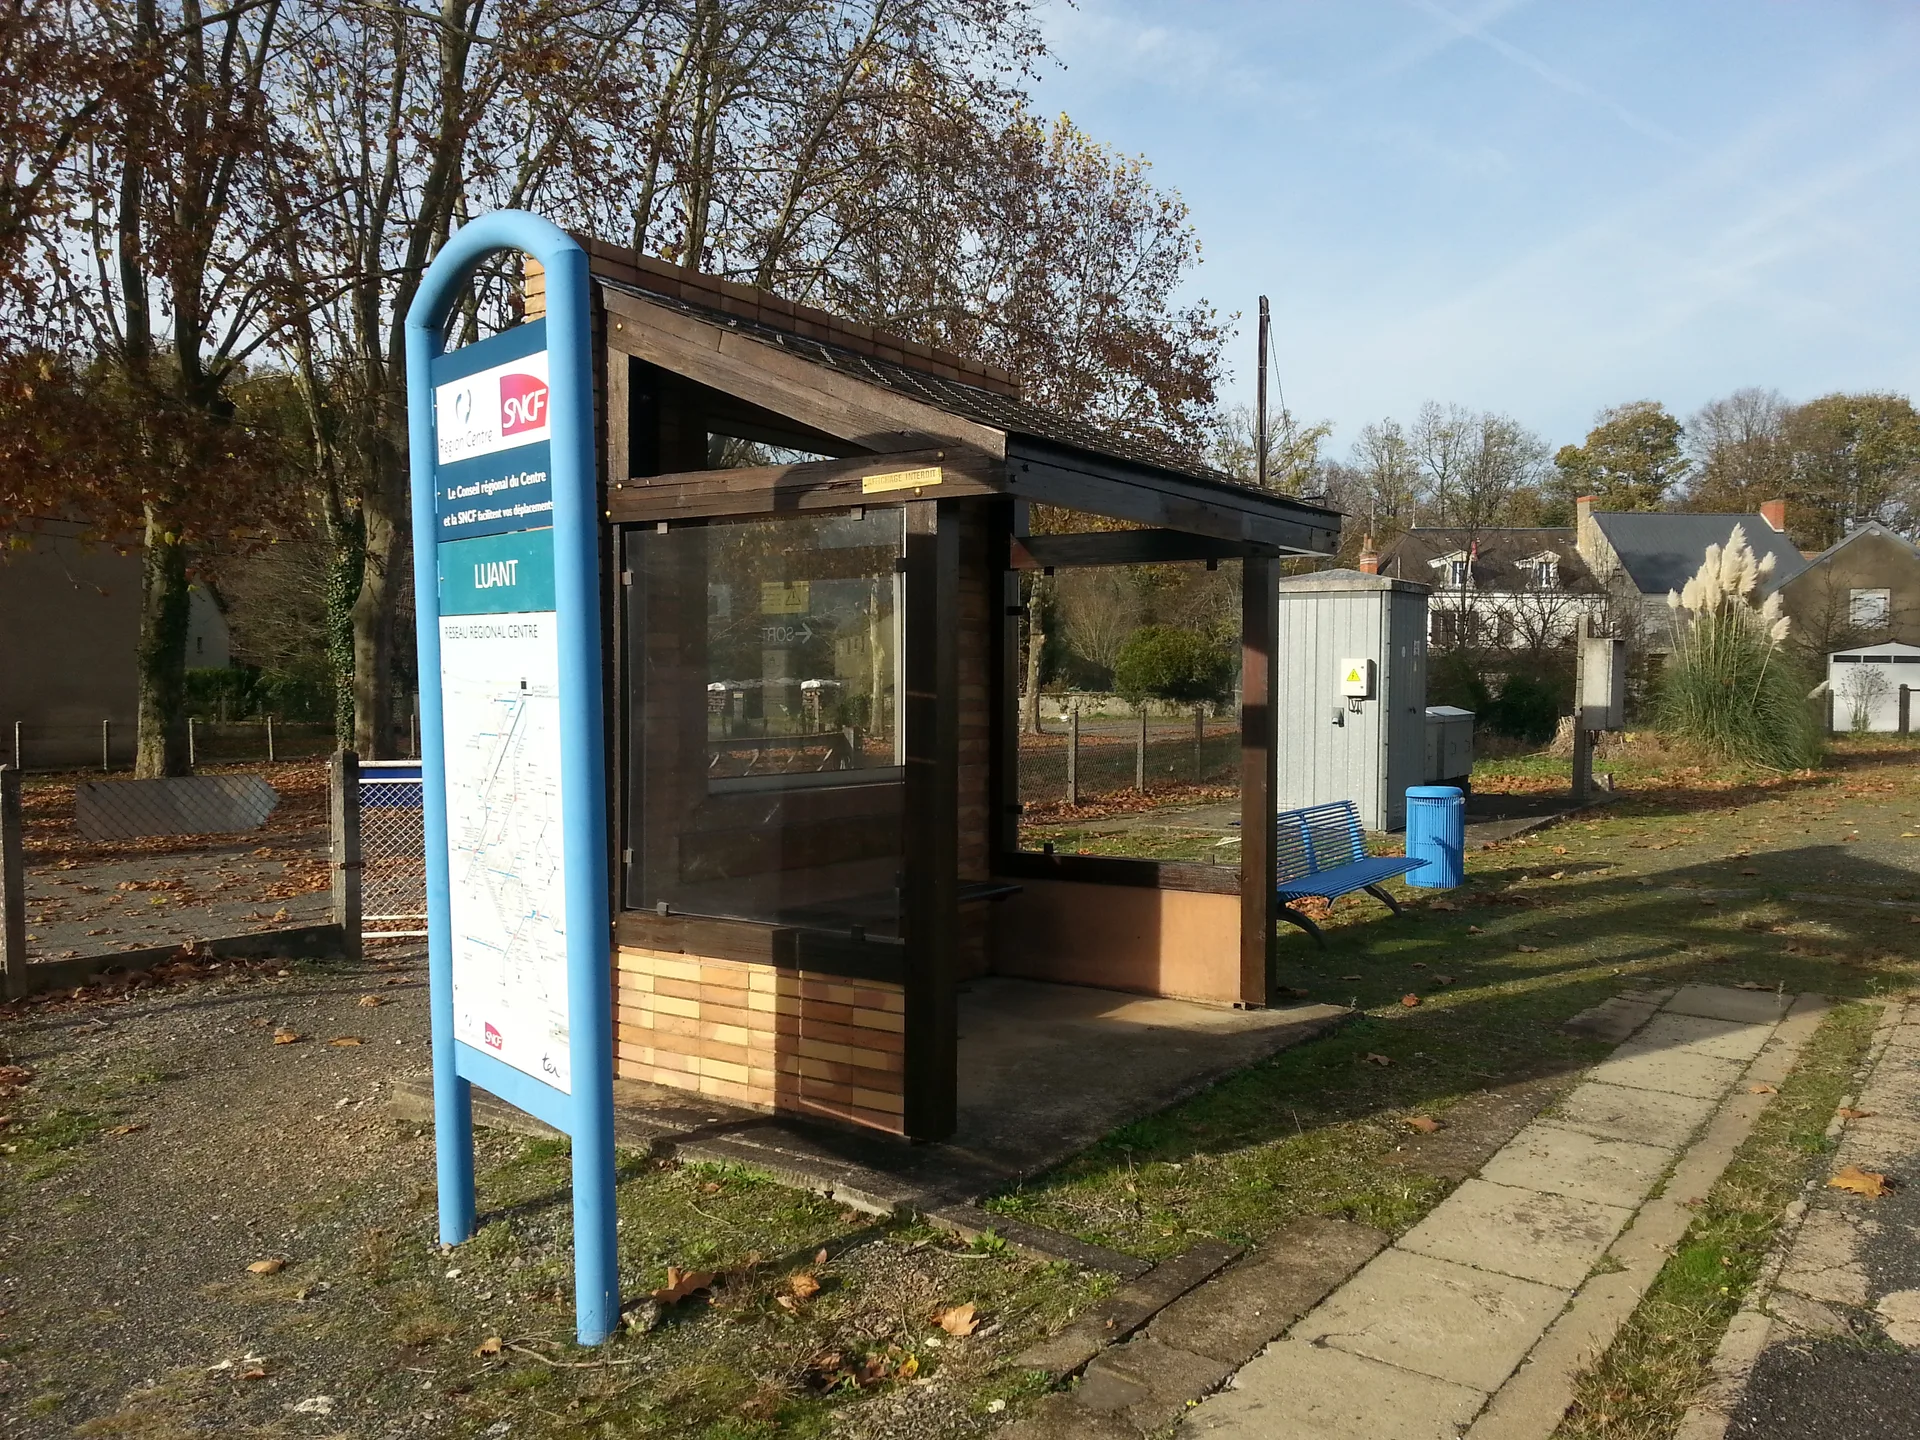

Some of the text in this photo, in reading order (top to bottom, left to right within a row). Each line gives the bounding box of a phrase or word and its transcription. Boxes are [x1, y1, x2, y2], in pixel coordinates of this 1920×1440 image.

[503, 388, 547, 429] SNCF
[466, 430, 492, 447] Centre
[448, 471, 546, 500] Le Conseil régional du Centre
[867, 469, 937, 486] AFFICHAGE INTERDIT
[444, 500, 554, 527] et la SNCF facilitent vos déplacements
[474, 560, 518, 588] LUANT
[508, 624, 538, 639] CENTRE
[485, 1031, 502, 1047] SNCF
